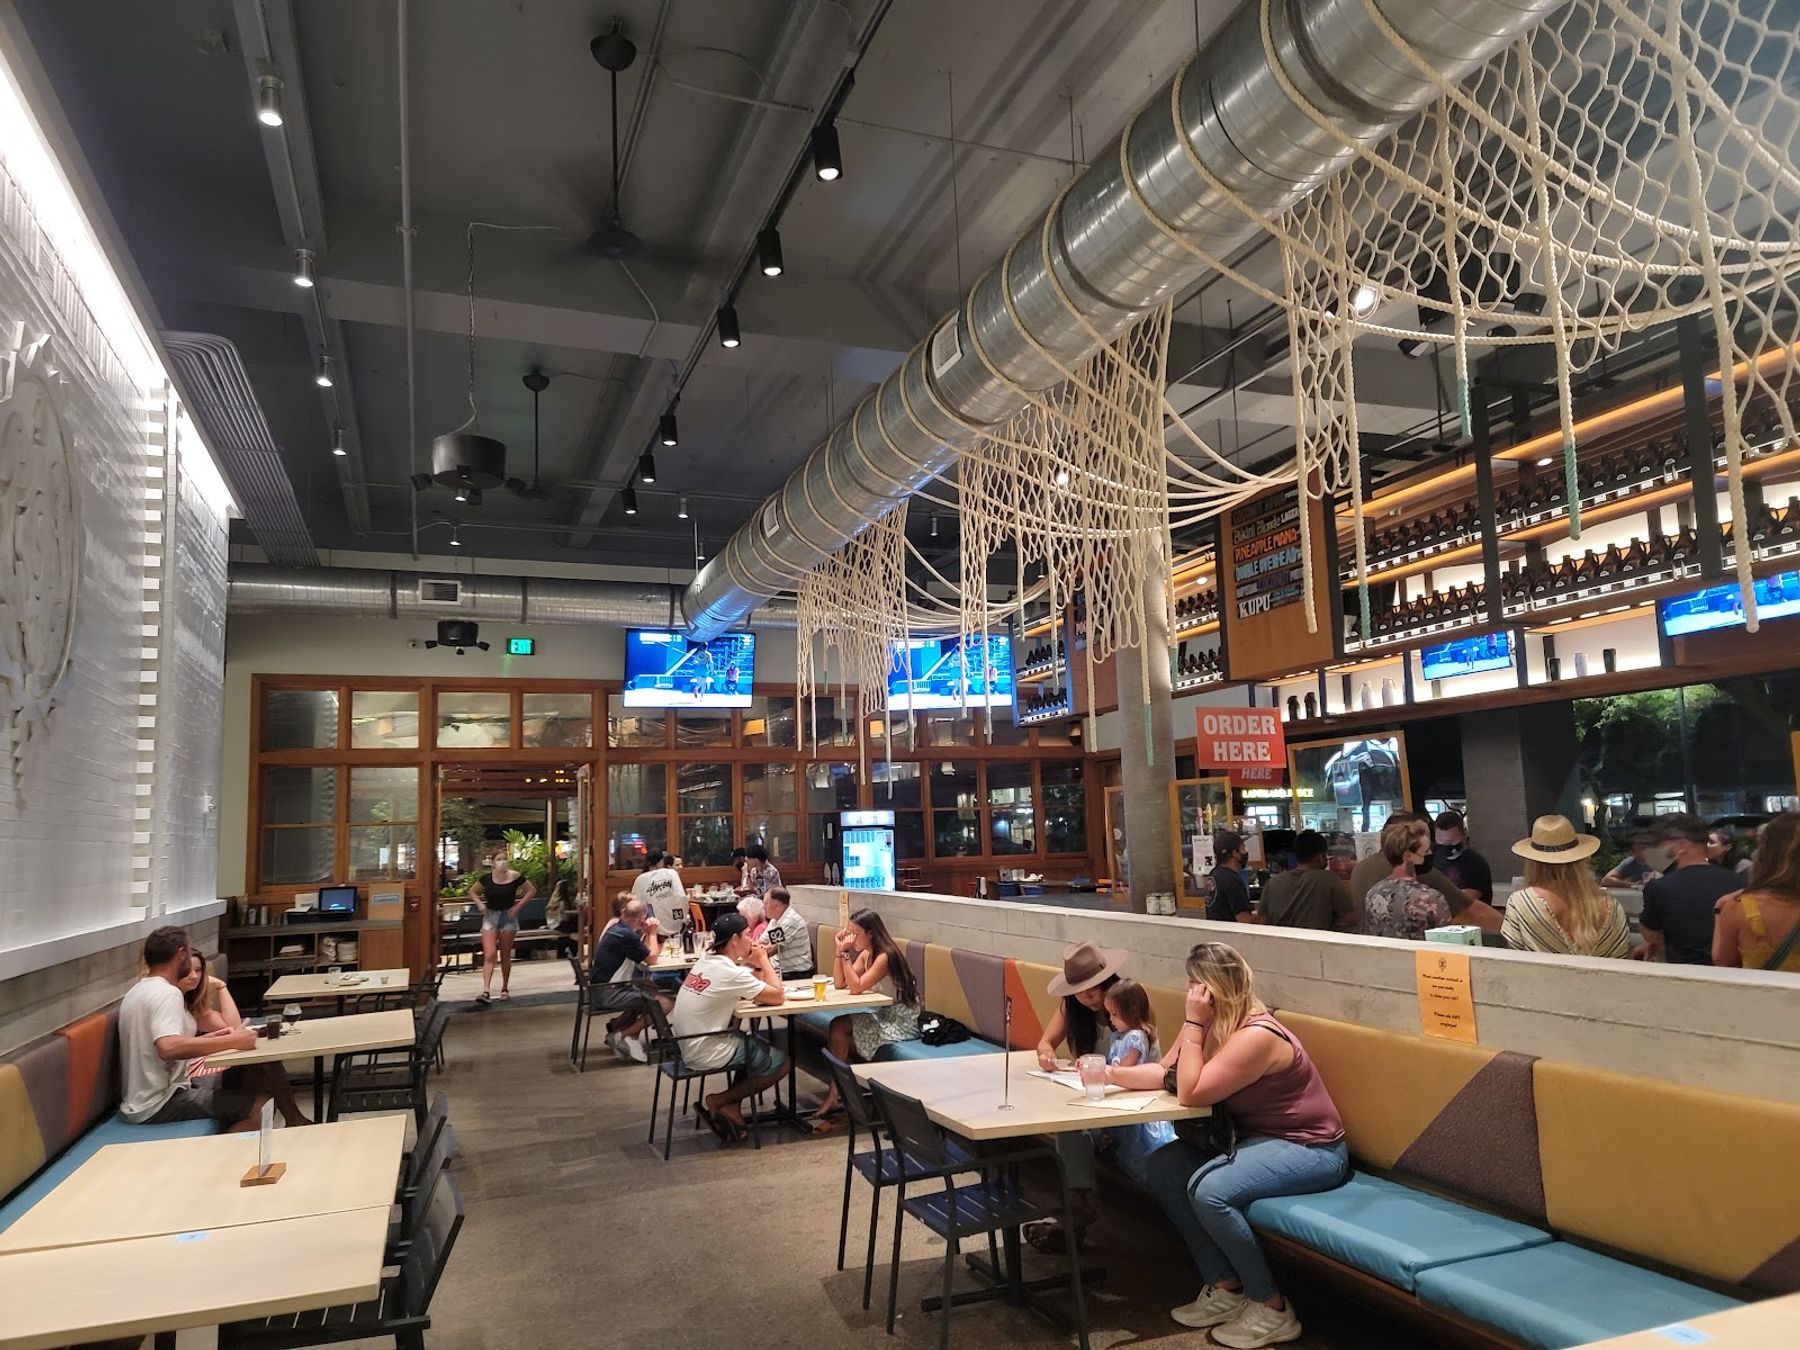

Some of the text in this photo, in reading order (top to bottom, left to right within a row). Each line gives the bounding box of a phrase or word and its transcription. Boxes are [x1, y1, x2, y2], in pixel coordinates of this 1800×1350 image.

[1235, 535, 1273, 563] PINEAPPLE
[1239, 593, 1271, 618] KUPU
[1203, 714, 1276, 735] ORDER
[1213, 741, 1271, 762] HERE
[1241, 768, 1272, 779] HERE
[770, 928, 784, 943] 92
